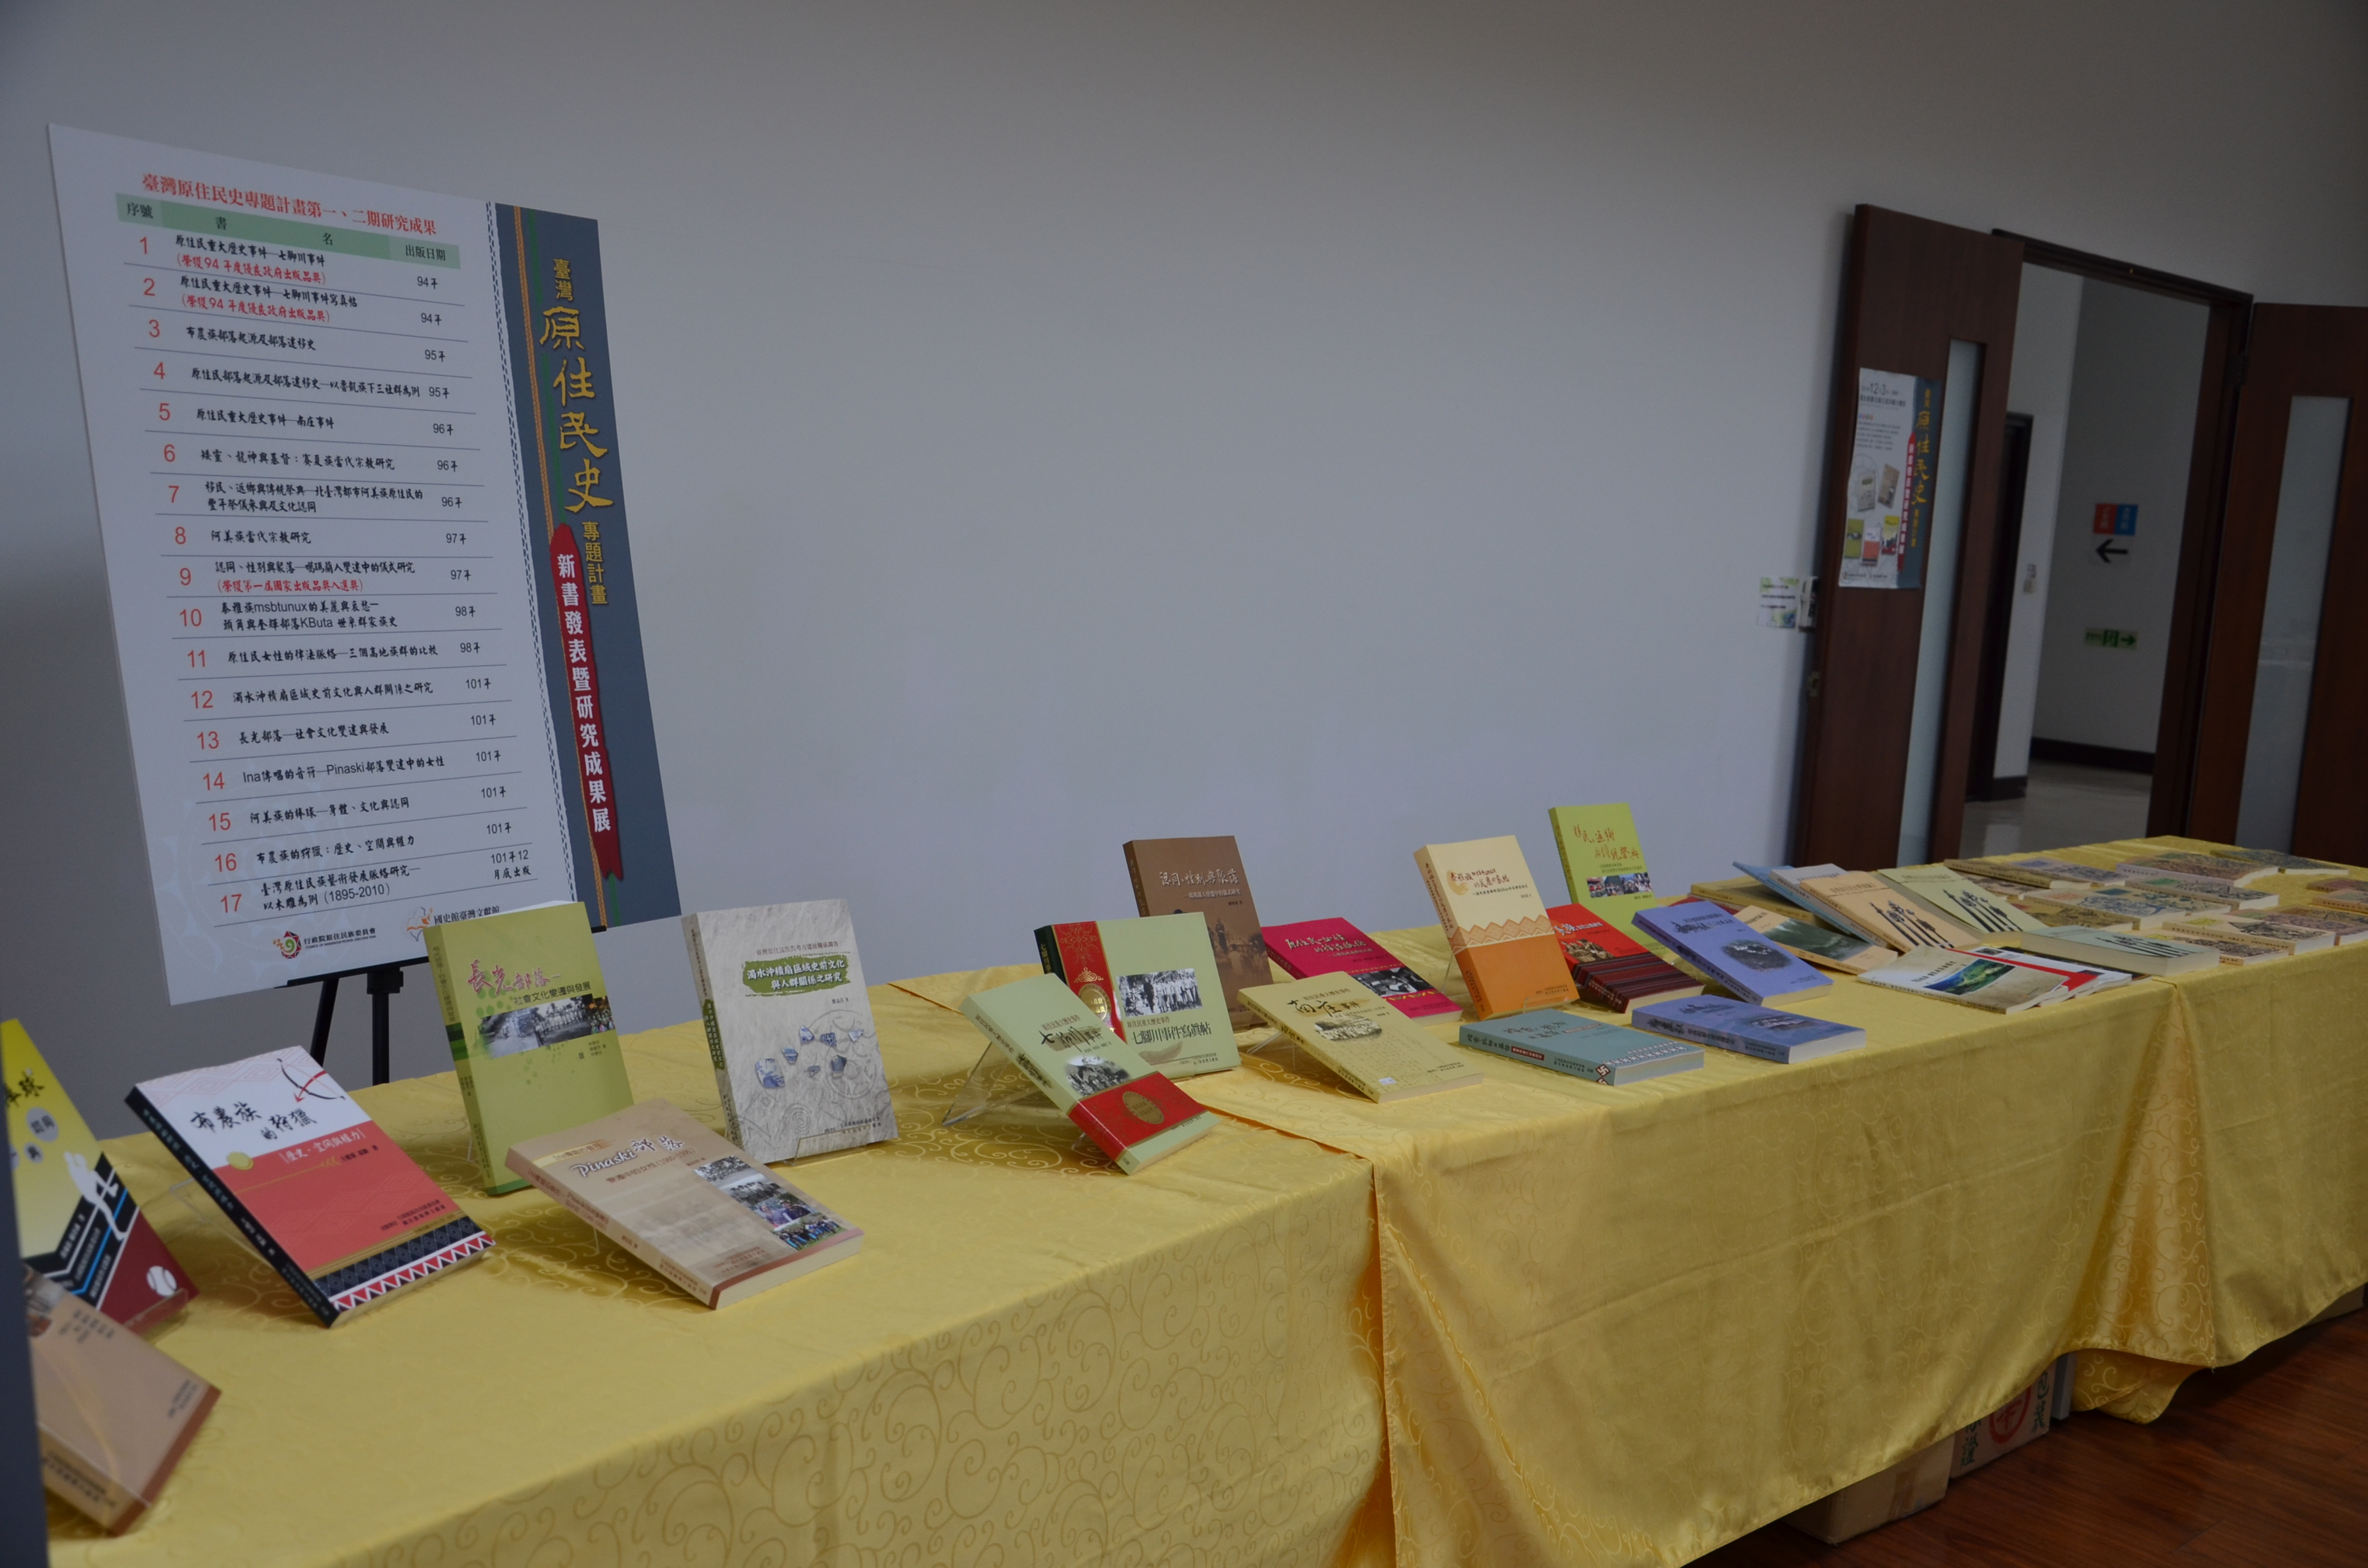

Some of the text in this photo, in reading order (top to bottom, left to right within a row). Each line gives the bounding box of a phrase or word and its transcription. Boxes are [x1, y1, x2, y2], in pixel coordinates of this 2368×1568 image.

[142, 174, 438, 236] 臺灣原住民史專題計畫第一、二期研究成果
[127, 202, 447, 261] 序號 書 名 出版日期
[139, 236, 147, 254] 1
[417, 276, 438, 290] 94年
[143, 277, 156, 296] 2
[421, 313, 442, 326] 94年
[148, 319, 161, 338] 3
[425, 350, 446, 363] 95年
[153, 361, 166, 380] 4
[429, 387, 450, 400] 95年
[159, 403, 171, 421] 5
[432, 423, 454, 436] 96年
[552, 258, 574, 302] 臺灣
[581, 520, 609, 605] 專題計畫
[163, 444, 176, 462] 6
[437, 460, 458, 472] 96年
[168, 485, 180, 503] 7
[441, 496, 462, 509] 96年
[175, 527, 466, 545] 8 阿美族當代宗教研究 97年
[179, 568, 192, 586] 9
[450, 569, 471, 582] 97年
[180, 608, 202, 627] 10
[456, 605, 475, 618] 98年
[187, 649, 206, 667] 11
[460, 642, 481, 654] 98年
[191, 690, 213, 709] 12
[466, 678, 491, 690] 101年
[556, 553, 612, 833] 新書發表暨研究成果展
[197, 731, 219, 750] 13
[470, 714, 496, 726] 101年
[202, 772, 225, 790] 14
[475, 750, 501, 762] 101年
[209, 812, 231, 831] 15
[481, 786, 507, 798] 101年
[215, 853, 237, 872] 16
[486, 822, 512, 834] 101年
[493, 865, 532, 881] 月底出版
[220, 894, 242, 913] 17
[747, 959, 846, 979] 濁水沖積扇區域史前文化
[771, 972, 843, 990] 與人群關係之研究
[513, 981, 591, 1006] 社會文化變遷與發展
[570, 1148, 638, 1178] Pinaski
